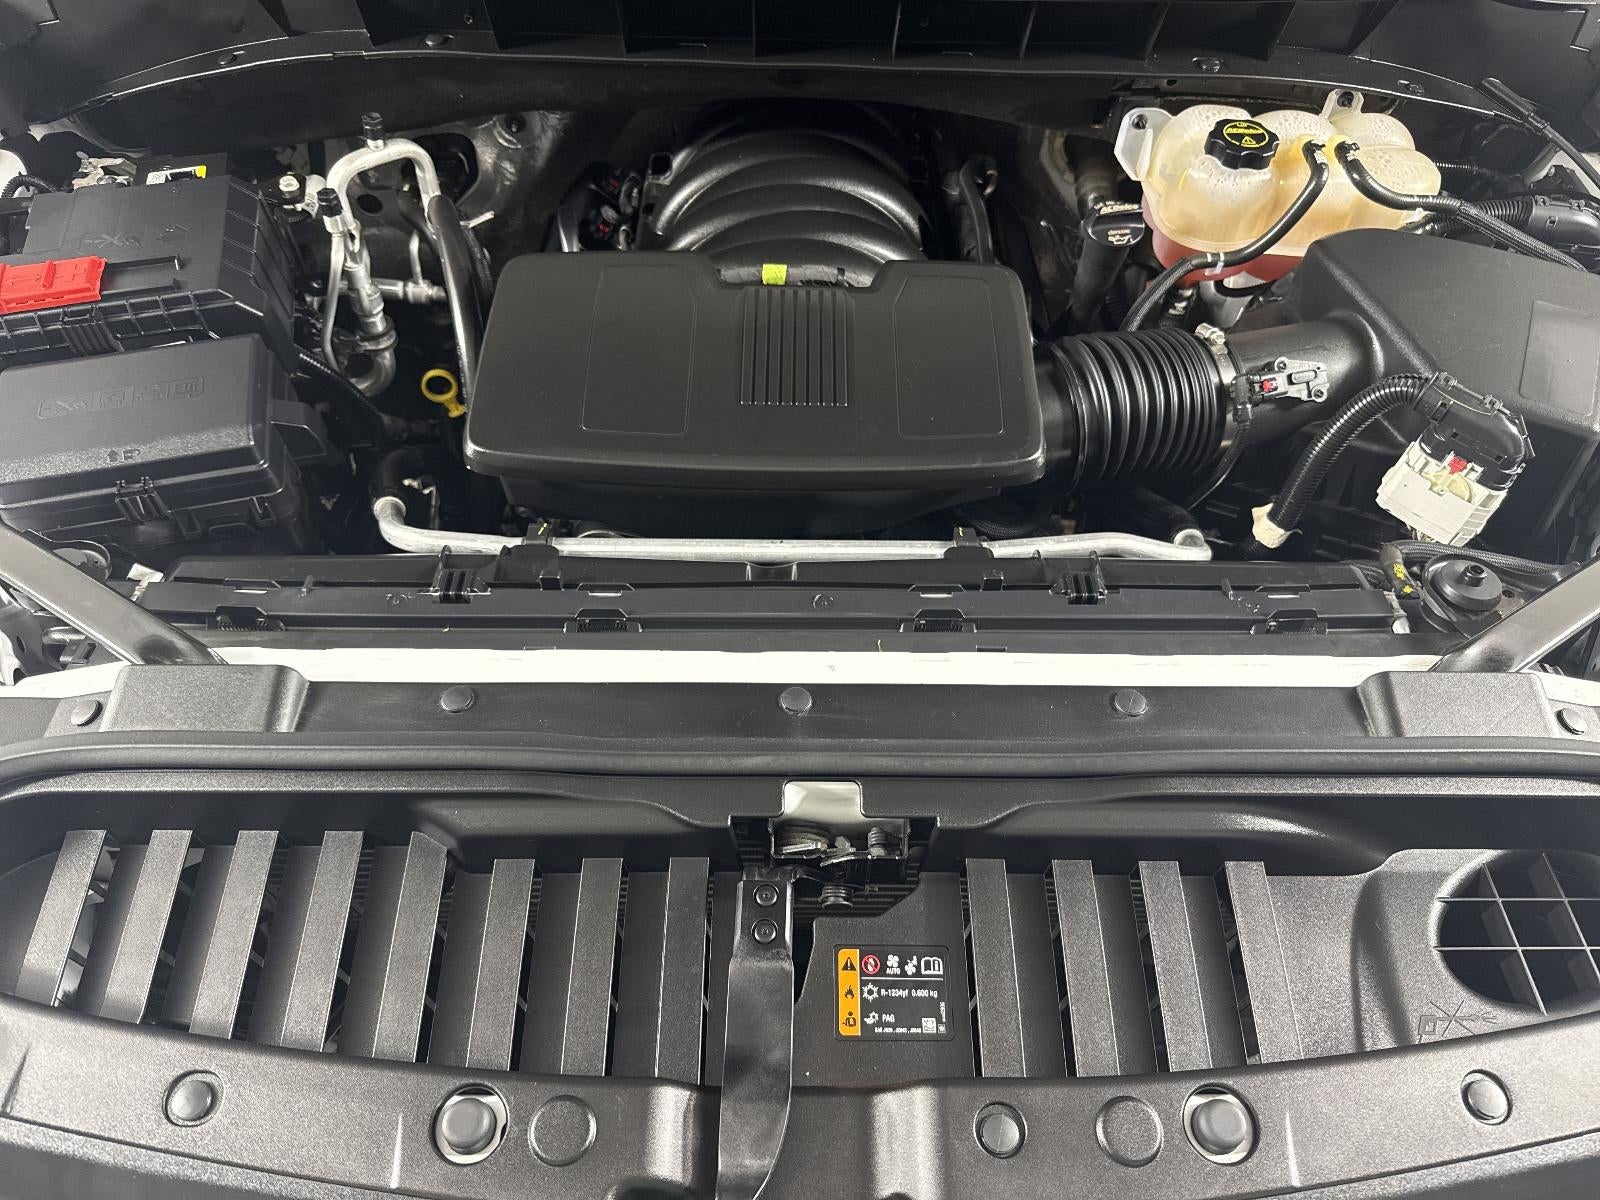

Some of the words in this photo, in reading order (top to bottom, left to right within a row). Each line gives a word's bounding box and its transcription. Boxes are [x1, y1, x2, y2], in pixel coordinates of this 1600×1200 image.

[1100, 203, 1139, 214] ACDelco
[886, 967, 901, 975] AUTO
[880, 988, 909, 998] R-1234yf
[911, 988, 929, 997] 0.600
[929, 989, 938, 998] kg
[881, 1013, 896, 1023] PAG
